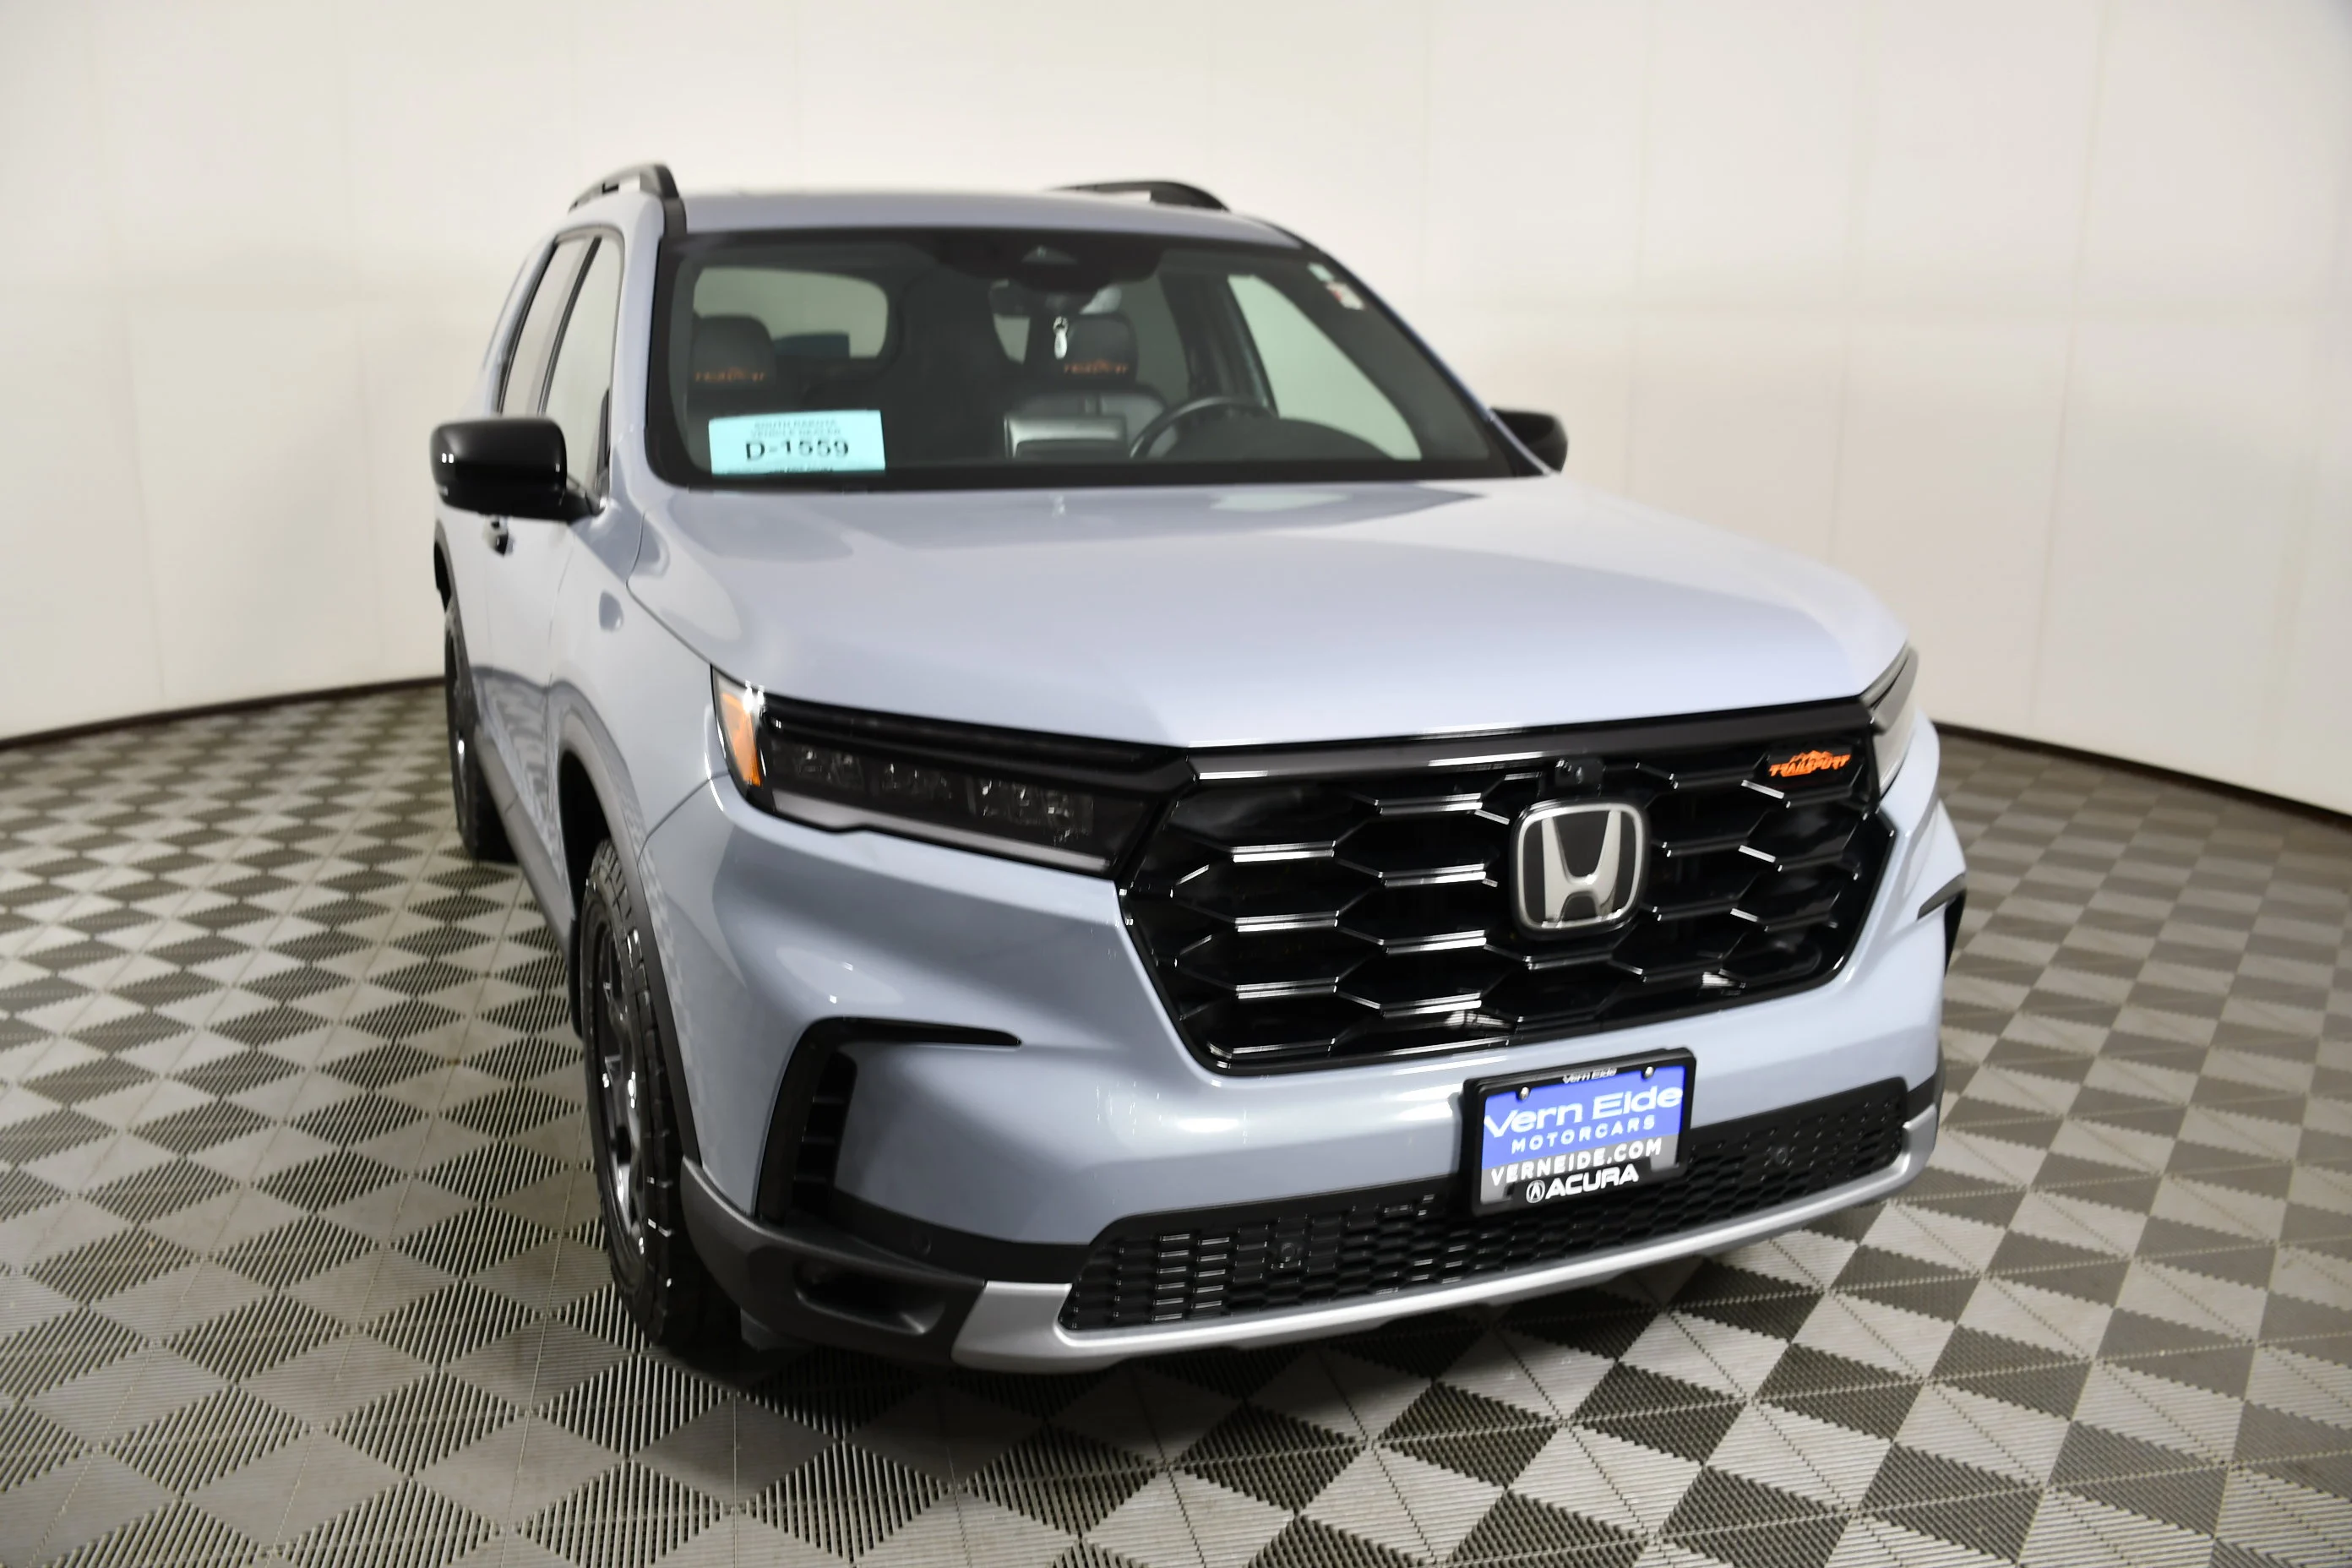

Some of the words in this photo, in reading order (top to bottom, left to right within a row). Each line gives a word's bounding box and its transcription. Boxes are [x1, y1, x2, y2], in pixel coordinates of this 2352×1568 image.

[746, 439, 849, 460] D-1559
[1562, 1073, 1591, 1085] Vern
[1484, 1102, 1583, 1138] Vern
[1511, 1114, 1656, 1155] MOTORCARS
[1491, 1137, 1663, 1187] VERNEIDE.COM
[1544, 1163, 1640, 1200] ACURA
